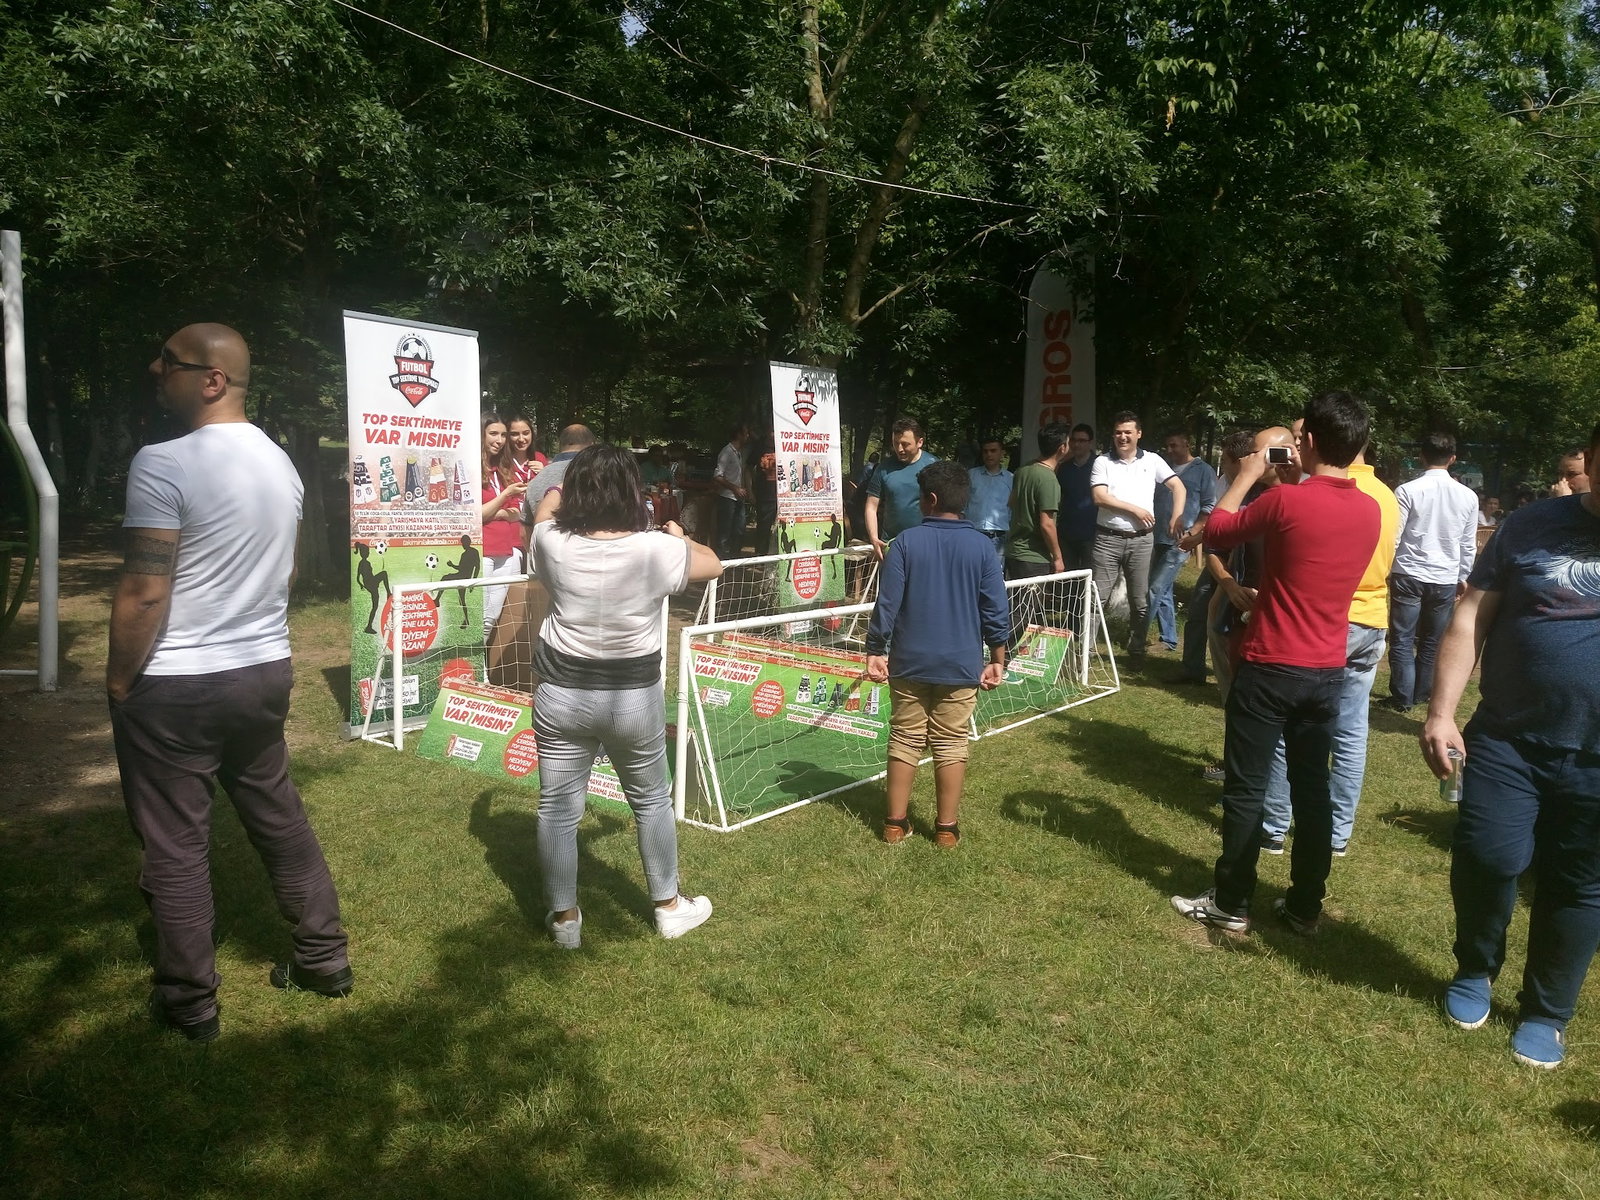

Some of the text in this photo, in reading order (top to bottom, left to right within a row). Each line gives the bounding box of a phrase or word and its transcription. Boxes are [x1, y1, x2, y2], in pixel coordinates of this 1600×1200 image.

[401, 361, 428, 375] FUTBOL
[362, 413, 462, 431] TOP SEKTİRMEYE
[365, 429, 461, 448] VAR MISIN?
[780, 431, 830, 441] TOP SEKTİRMEYE
[782, 442, 830, 454] VAR MISIN?
[696, 655, 711, 664] TOP
[695, 664, 716, 676] VAR
[448, 696, 520, 719] TOP SEKTİRMEYE
[444, 706, 514, 732] VAR MISIN?
